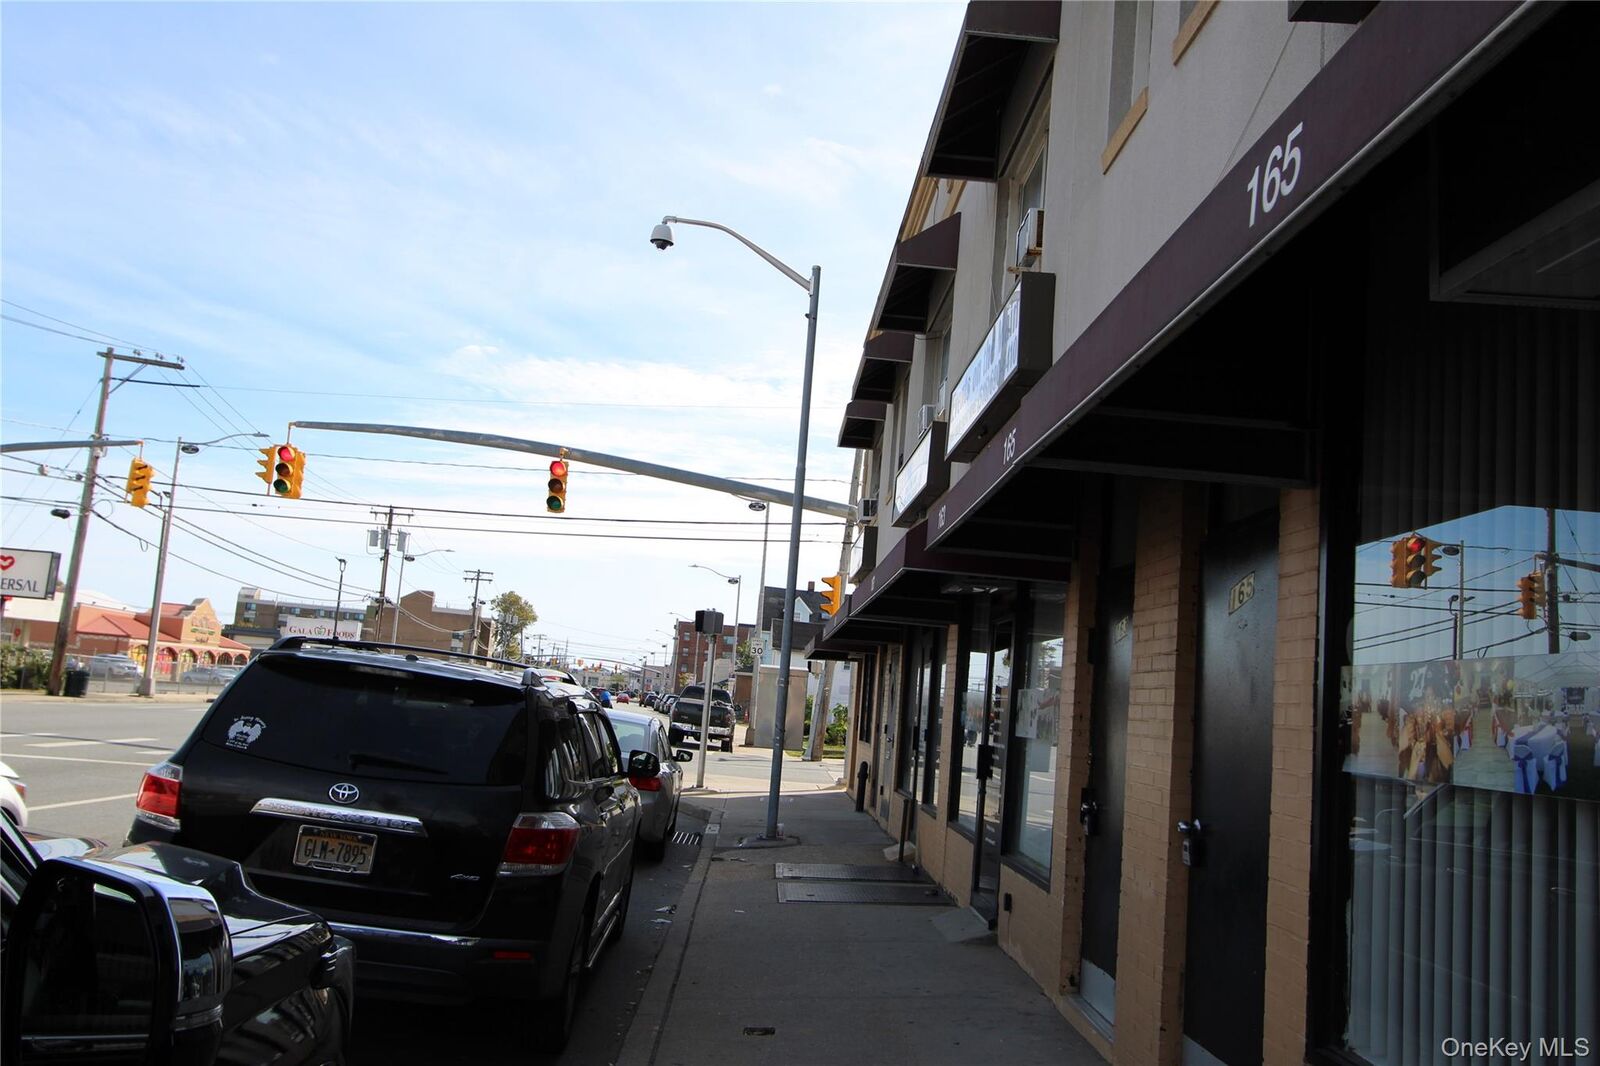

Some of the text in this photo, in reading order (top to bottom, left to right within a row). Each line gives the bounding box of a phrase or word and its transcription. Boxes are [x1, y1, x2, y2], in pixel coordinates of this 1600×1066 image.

[1246, 121, 1303, 228] 165
[1003, 428, 1017, 465] 165
[1232, 580, 1253, 610] 165
[289, 626, 313, 635] GALA
[751, 647, 763, 655] 30
